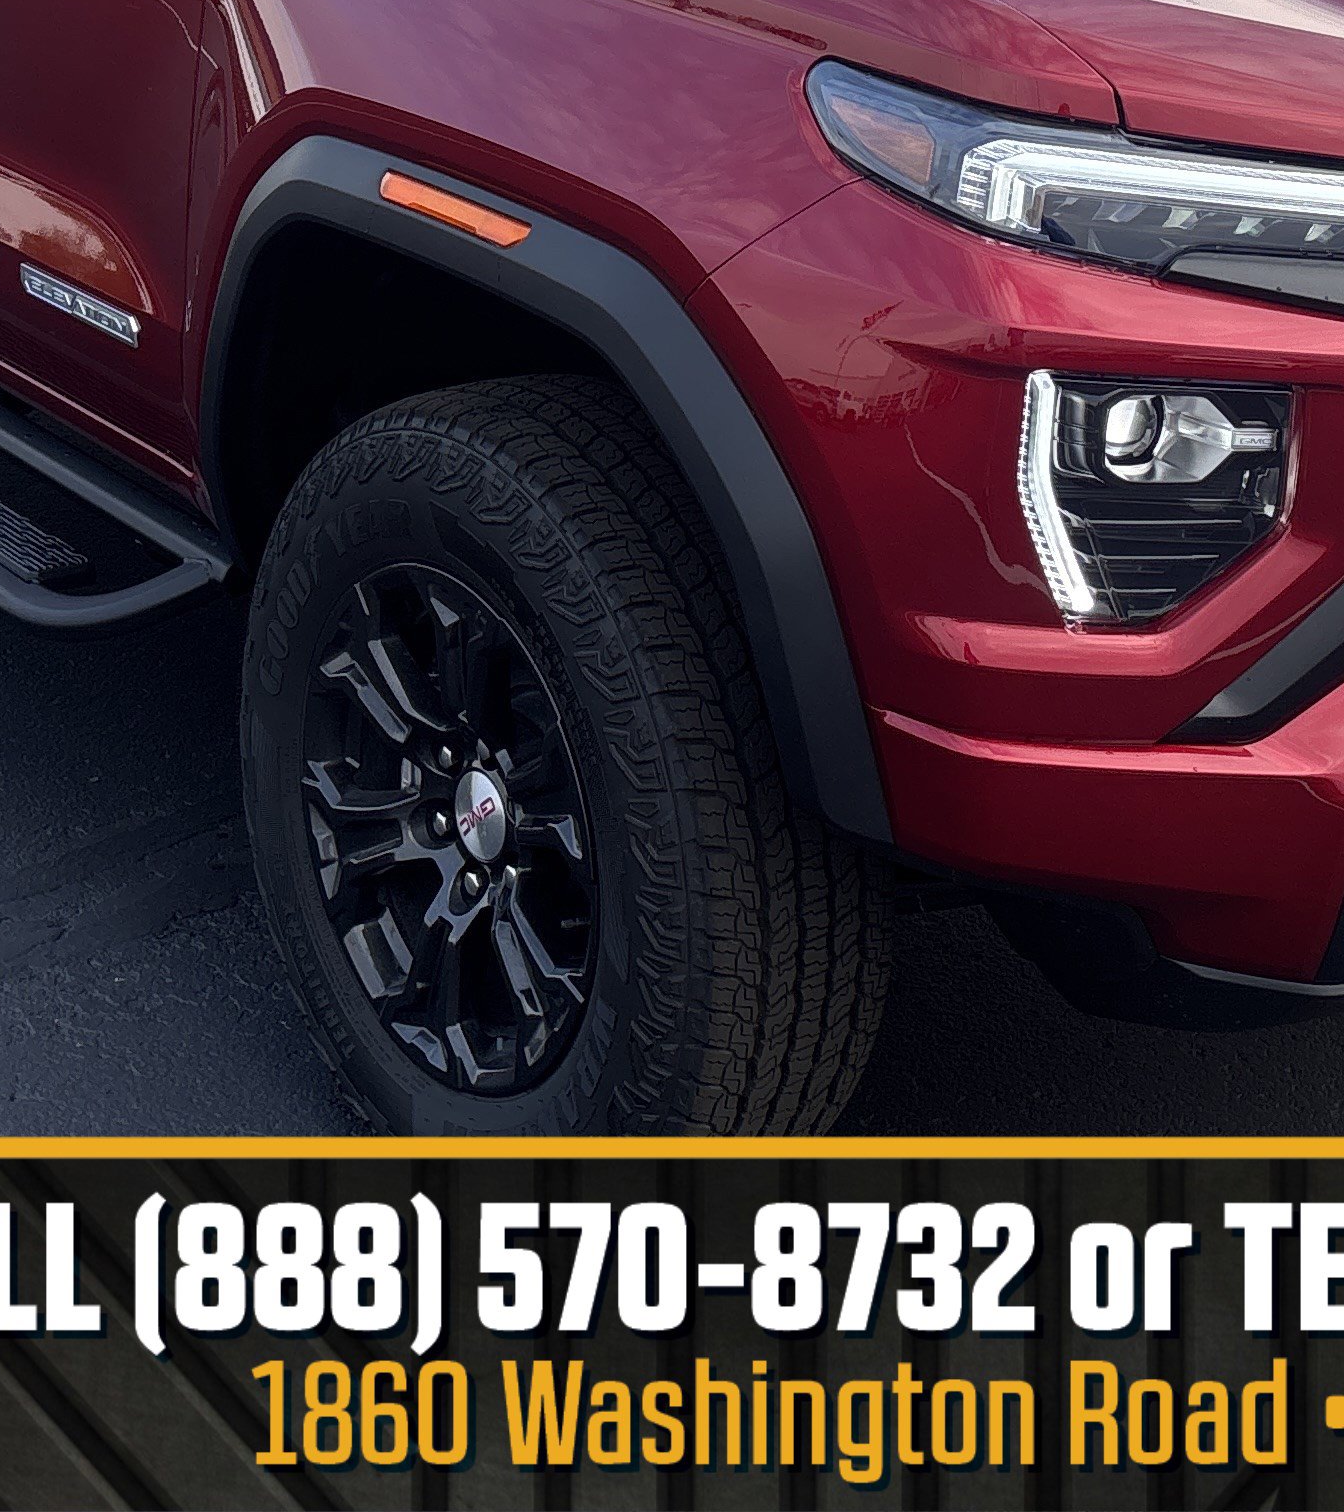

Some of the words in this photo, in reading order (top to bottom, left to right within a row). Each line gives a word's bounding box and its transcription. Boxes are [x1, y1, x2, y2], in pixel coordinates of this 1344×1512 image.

[27, 271, 134, 340] ELEVATION
[1239, 437, 1272, 445] GMC
[459, 796, 496, 837] GMC
